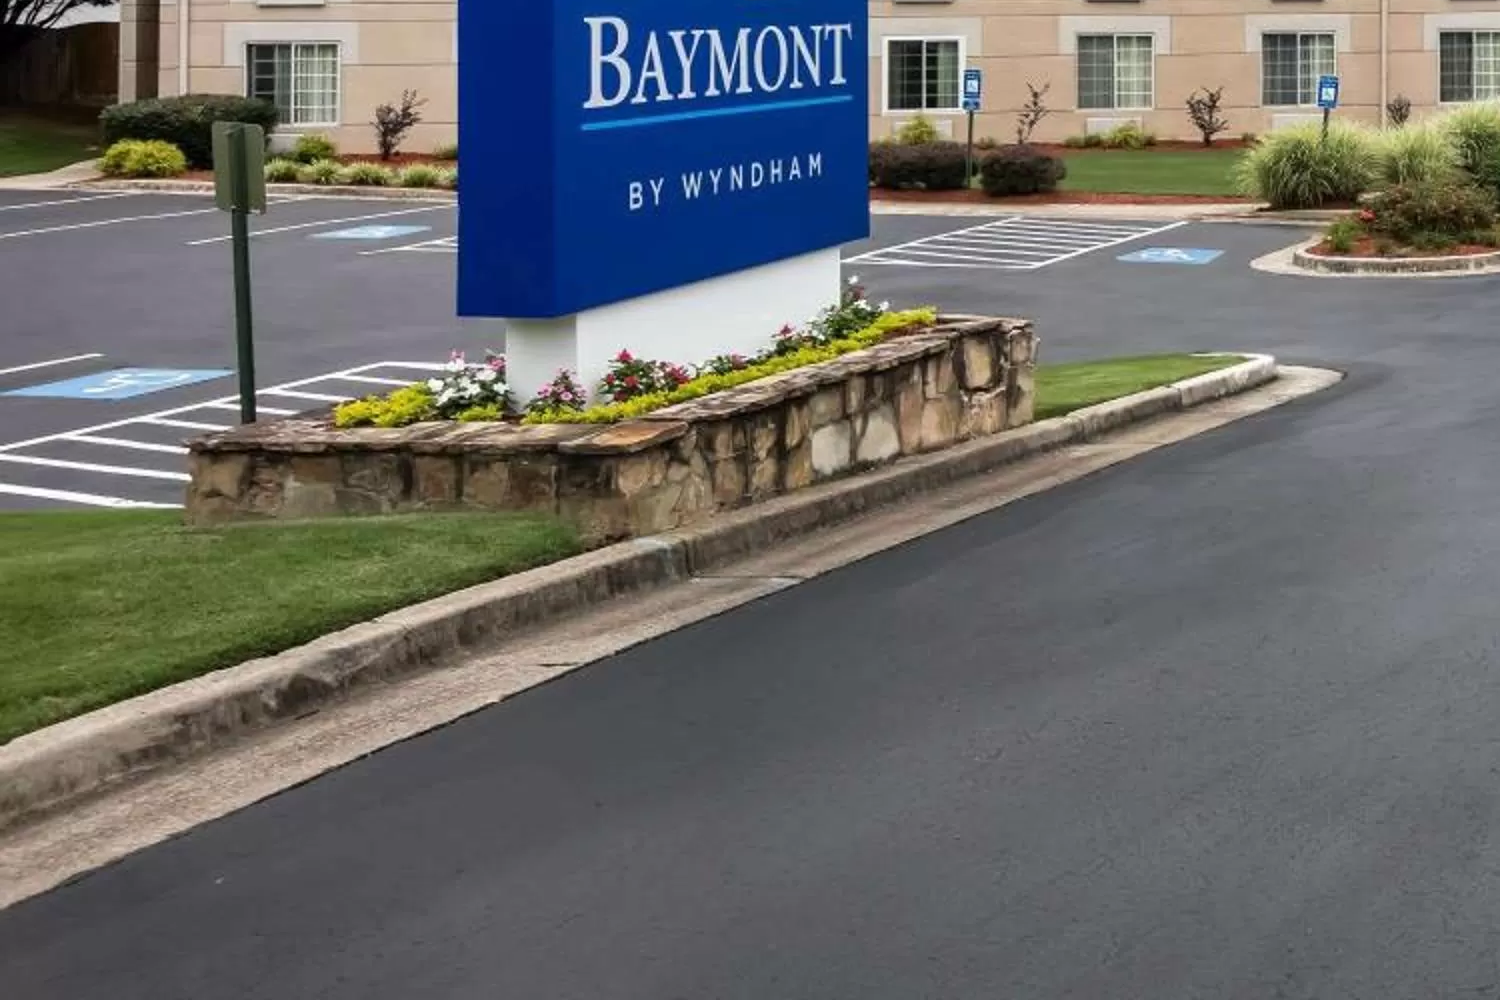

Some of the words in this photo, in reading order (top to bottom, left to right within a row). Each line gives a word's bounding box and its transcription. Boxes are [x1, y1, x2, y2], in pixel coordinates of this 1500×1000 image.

[583, 16, 852, 109] BAYMONT
[629, 178, 664, 210] BY
[682, 152, 821, 199] WYNDHAM
